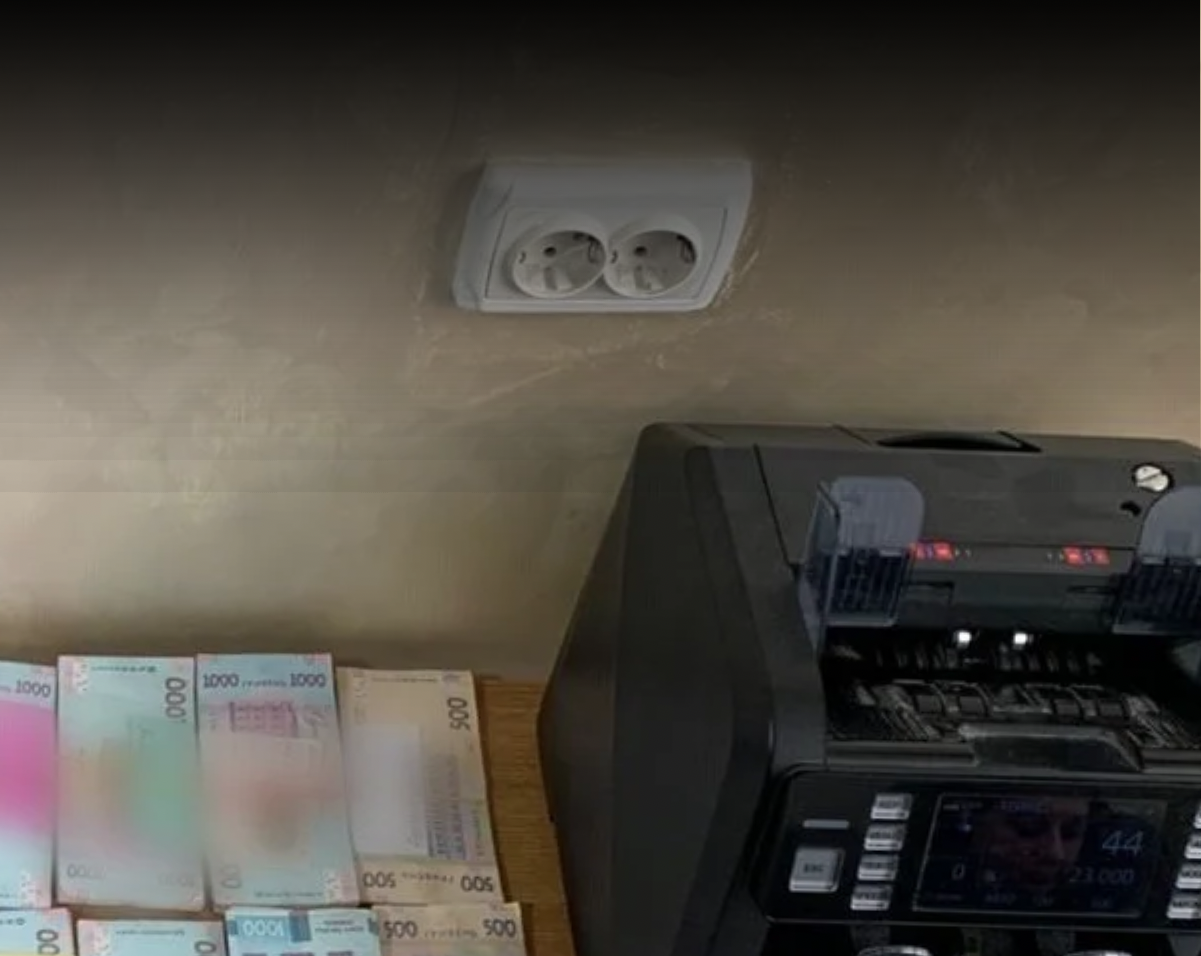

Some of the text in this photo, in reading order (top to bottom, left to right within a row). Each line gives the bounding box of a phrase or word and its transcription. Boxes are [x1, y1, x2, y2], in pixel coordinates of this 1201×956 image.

[14, 680, 51, 699] 1000
[203, 673, 239, 689] 1000
[289, 673, 326, 688] 1000
[165, 677, 187, 724] 000
[446, 697, 471, 731] 500
[1102, 829, 1144, 855] 44
[363, 873, 397, 889] 500
[460, 876, 494, 892] 500
[383, 920, 418, 939] 500
[482, 918, 518, 938] 500
